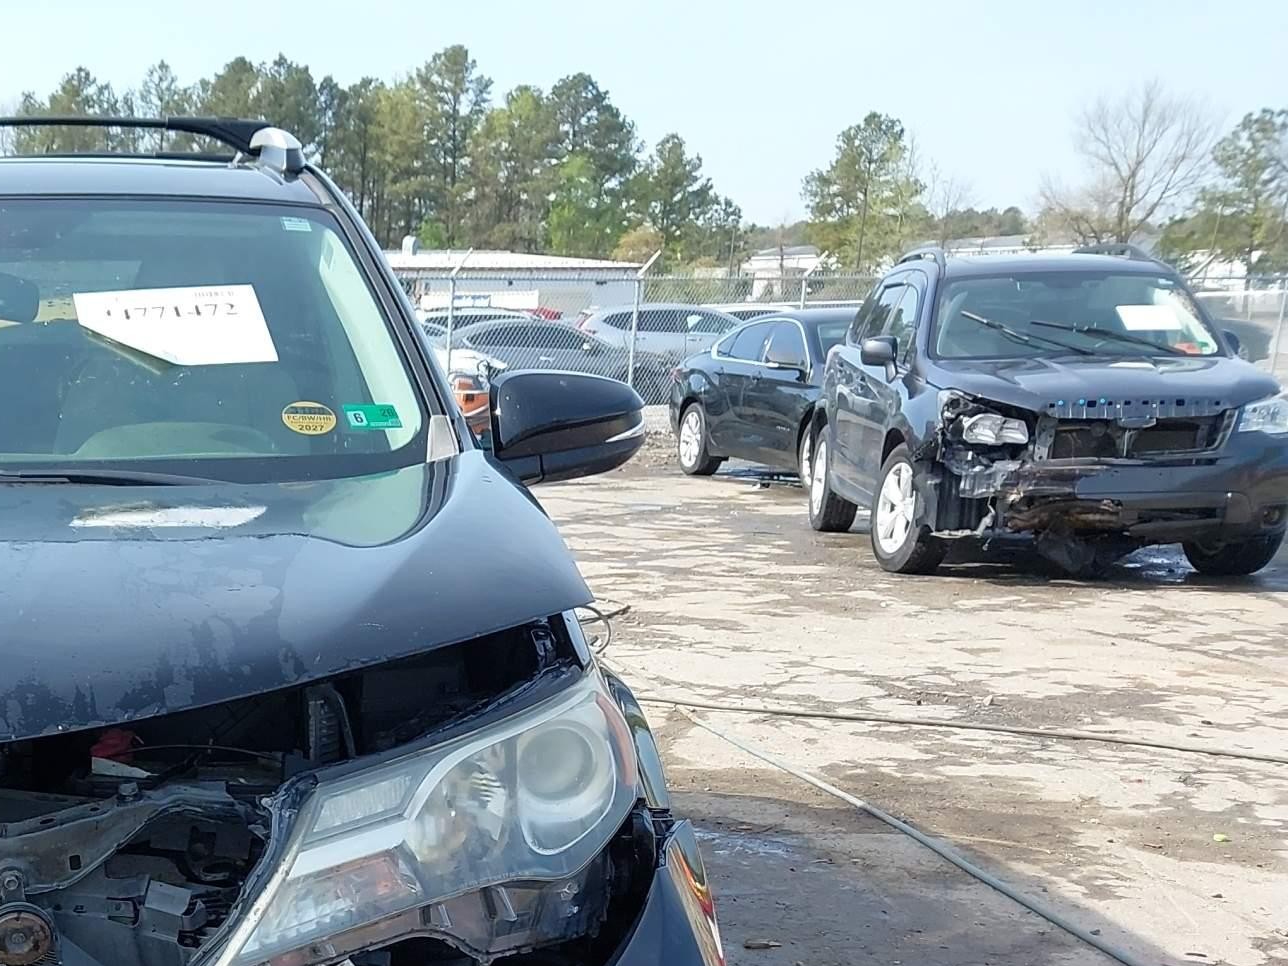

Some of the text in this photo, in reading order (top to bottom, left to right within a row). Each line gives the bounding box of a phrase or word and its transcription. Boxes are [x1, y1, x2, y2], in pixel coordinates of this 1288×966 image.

[104, 302, 239, 320] 771472
[353, 412, 364, 423] 6
[297, 424, 324, 432] 2027
